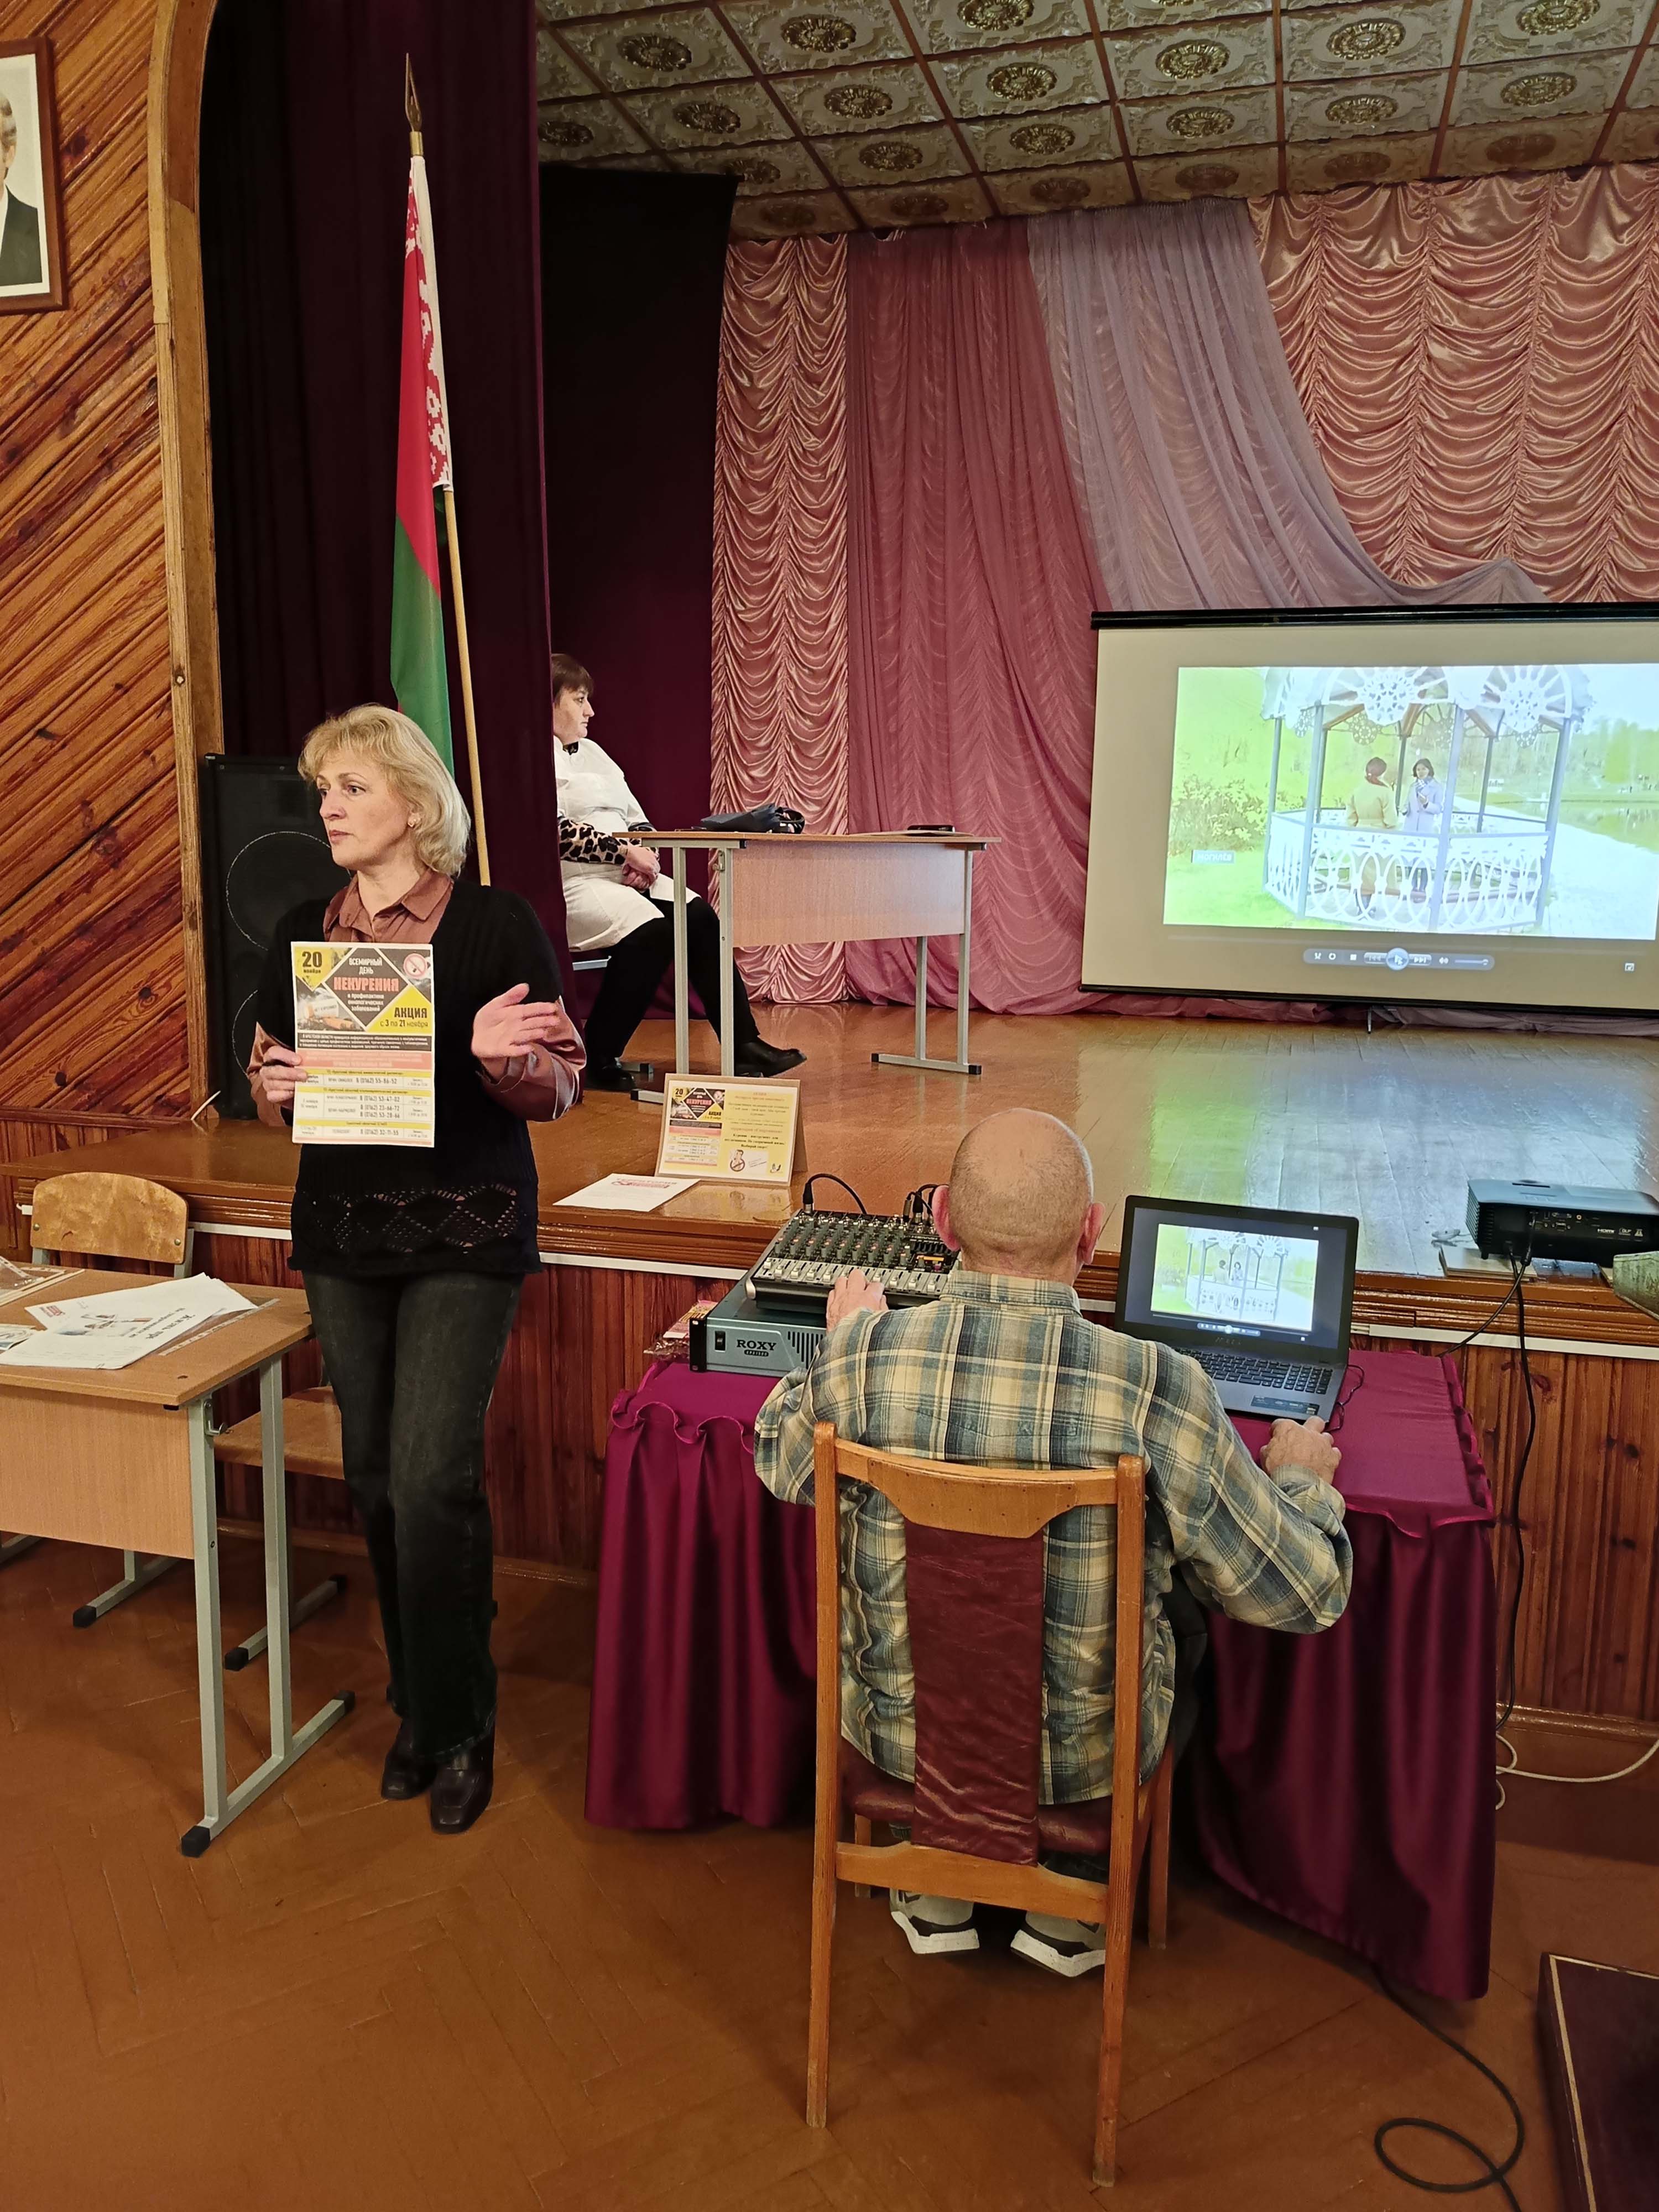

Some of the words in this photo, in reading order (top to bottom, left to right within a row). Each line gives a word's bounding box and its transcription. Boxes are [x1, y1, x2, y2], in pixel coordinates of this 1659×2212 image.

[301, 951, 322, 968] 20
[349, 957, 383, 966] ВСЕМИРНЫЙ
[359, 966, 374, 975] ДЕНЬ
[333, 977, 399, 992] НЕКУРЕНИЯ
[394, 1007, 428, 1020] АКЦИЯ
[736, 1339, 777, 1351] ROXY
